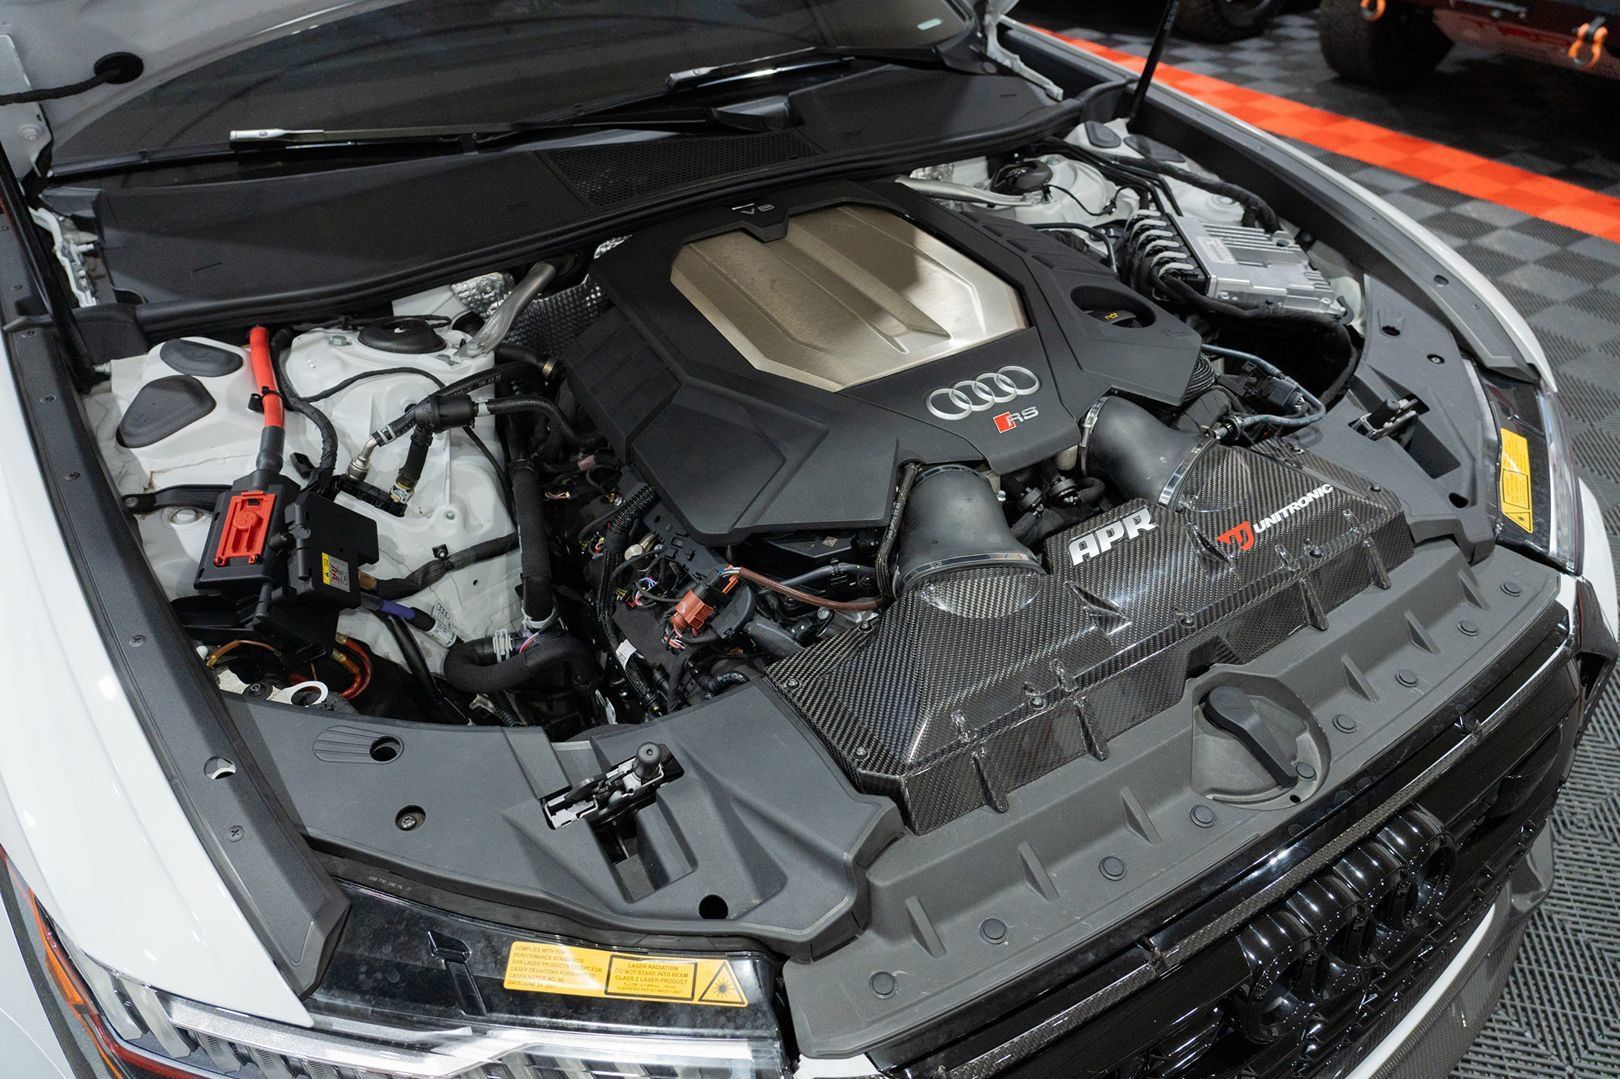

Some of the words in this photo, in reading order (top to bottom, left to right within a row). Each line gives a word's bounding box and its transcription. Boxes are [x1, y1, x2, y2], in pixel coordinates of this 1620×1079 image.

[1005, 406, 1039, 428] RS
[1253, 484, 1333, 534] UNITRONIC
[1069, 508, 1159, 566] APR
[514, 952, 552, 960] PERFORMANCE
